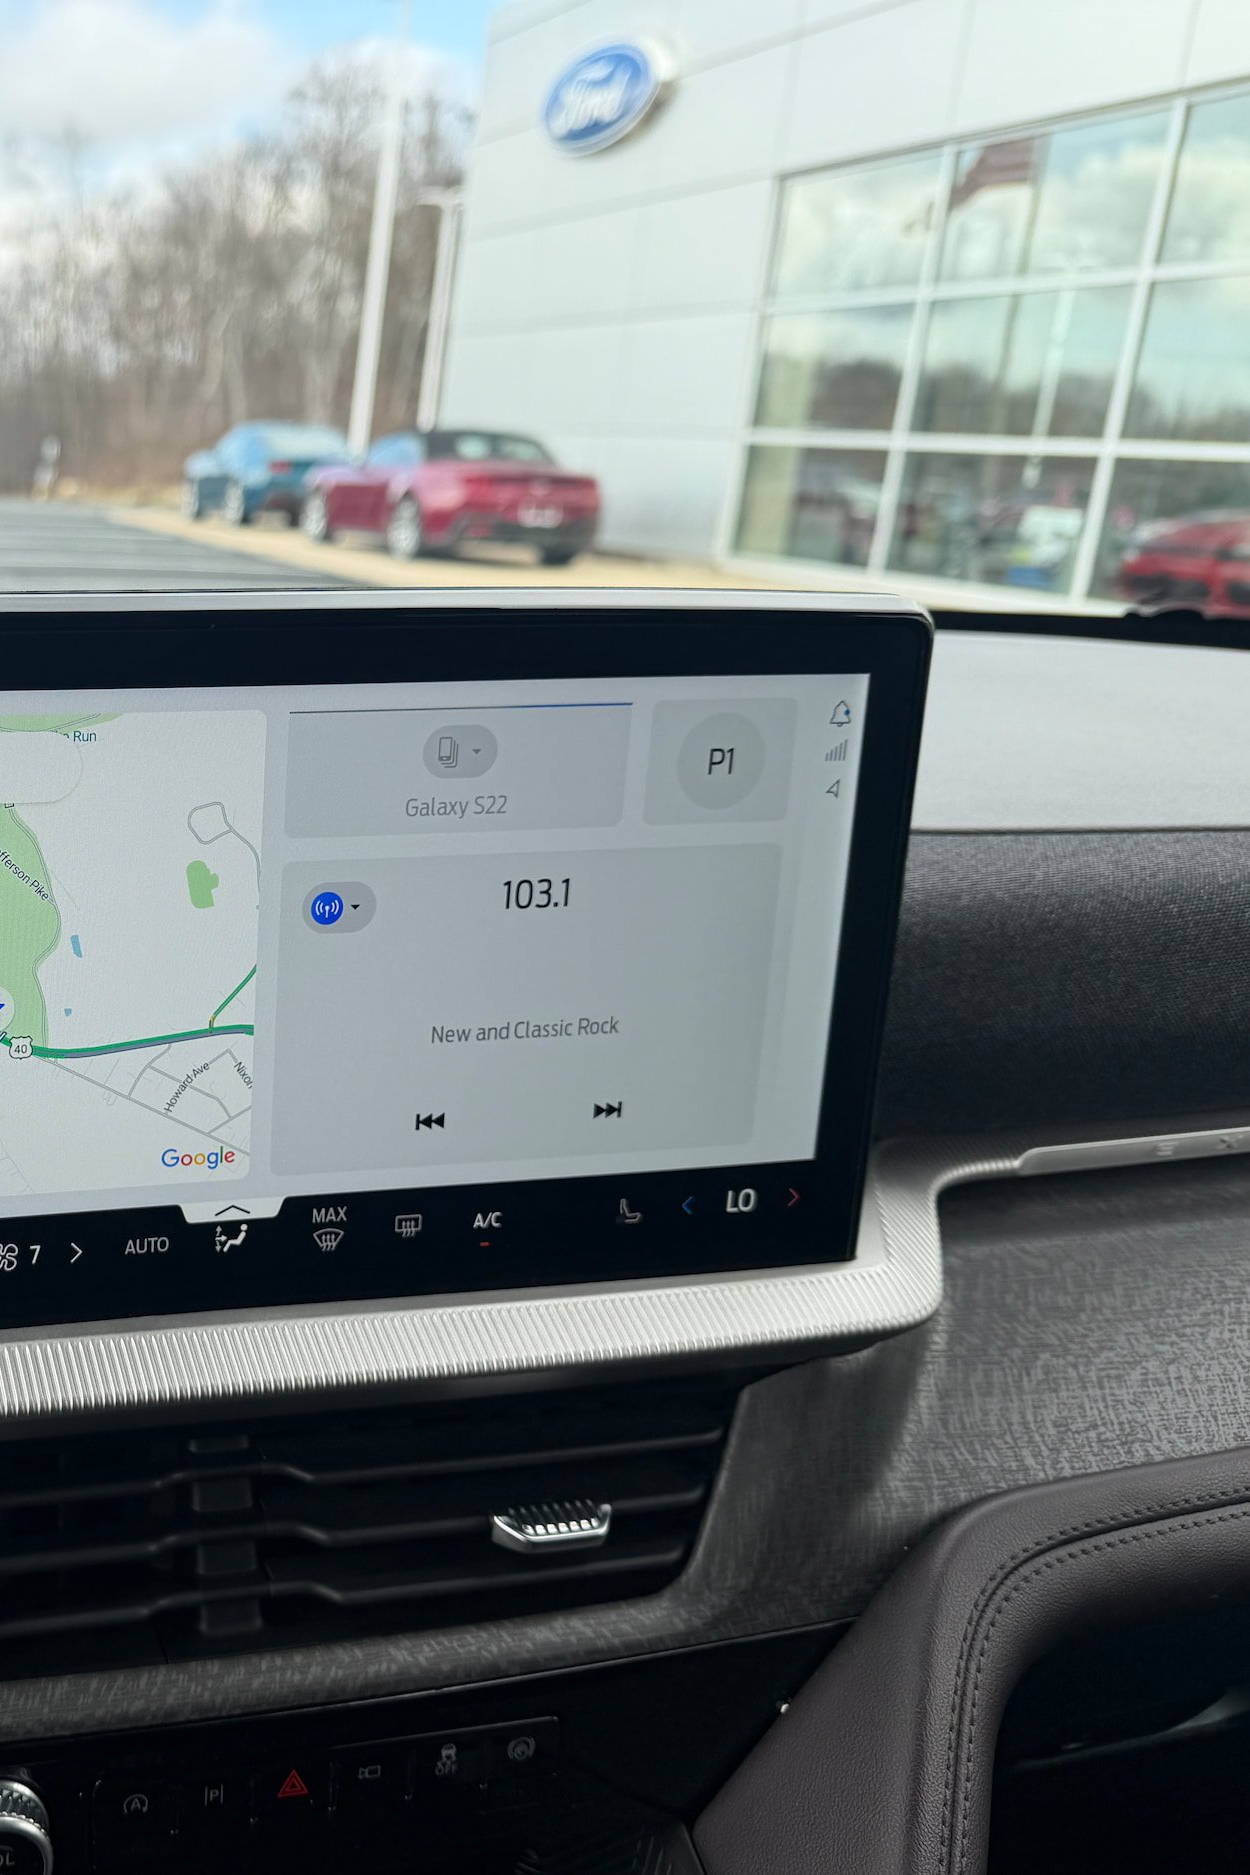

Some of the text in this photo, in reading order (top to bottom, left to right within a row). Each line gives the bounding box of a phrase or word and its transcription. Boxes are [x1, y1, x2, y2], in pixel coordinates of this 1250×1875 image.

[73, 730, 97, 742] Run
[707, 747, 736, 775] P1
[405, 795, 509, 820] Galaxy S22
[28, 878, 50, 902] Pike
[502, 878, 571, 909] 103.1
[431, 1015, 619, 1044] New and Classic Rock
[13, 1044, 27, 1055] 40
[163, 1062, 210, 1113] Howard Ave
[161, 1145, 236, 1170] Google
[726, 1187, 757, 1213] LO
[312, 1206, 347, 1223] MAX
[473, 1210, 502, 1229] A/C
[29, 1245, 41, 1266] 7
[124, 1236, 170, 1256] AUTO
